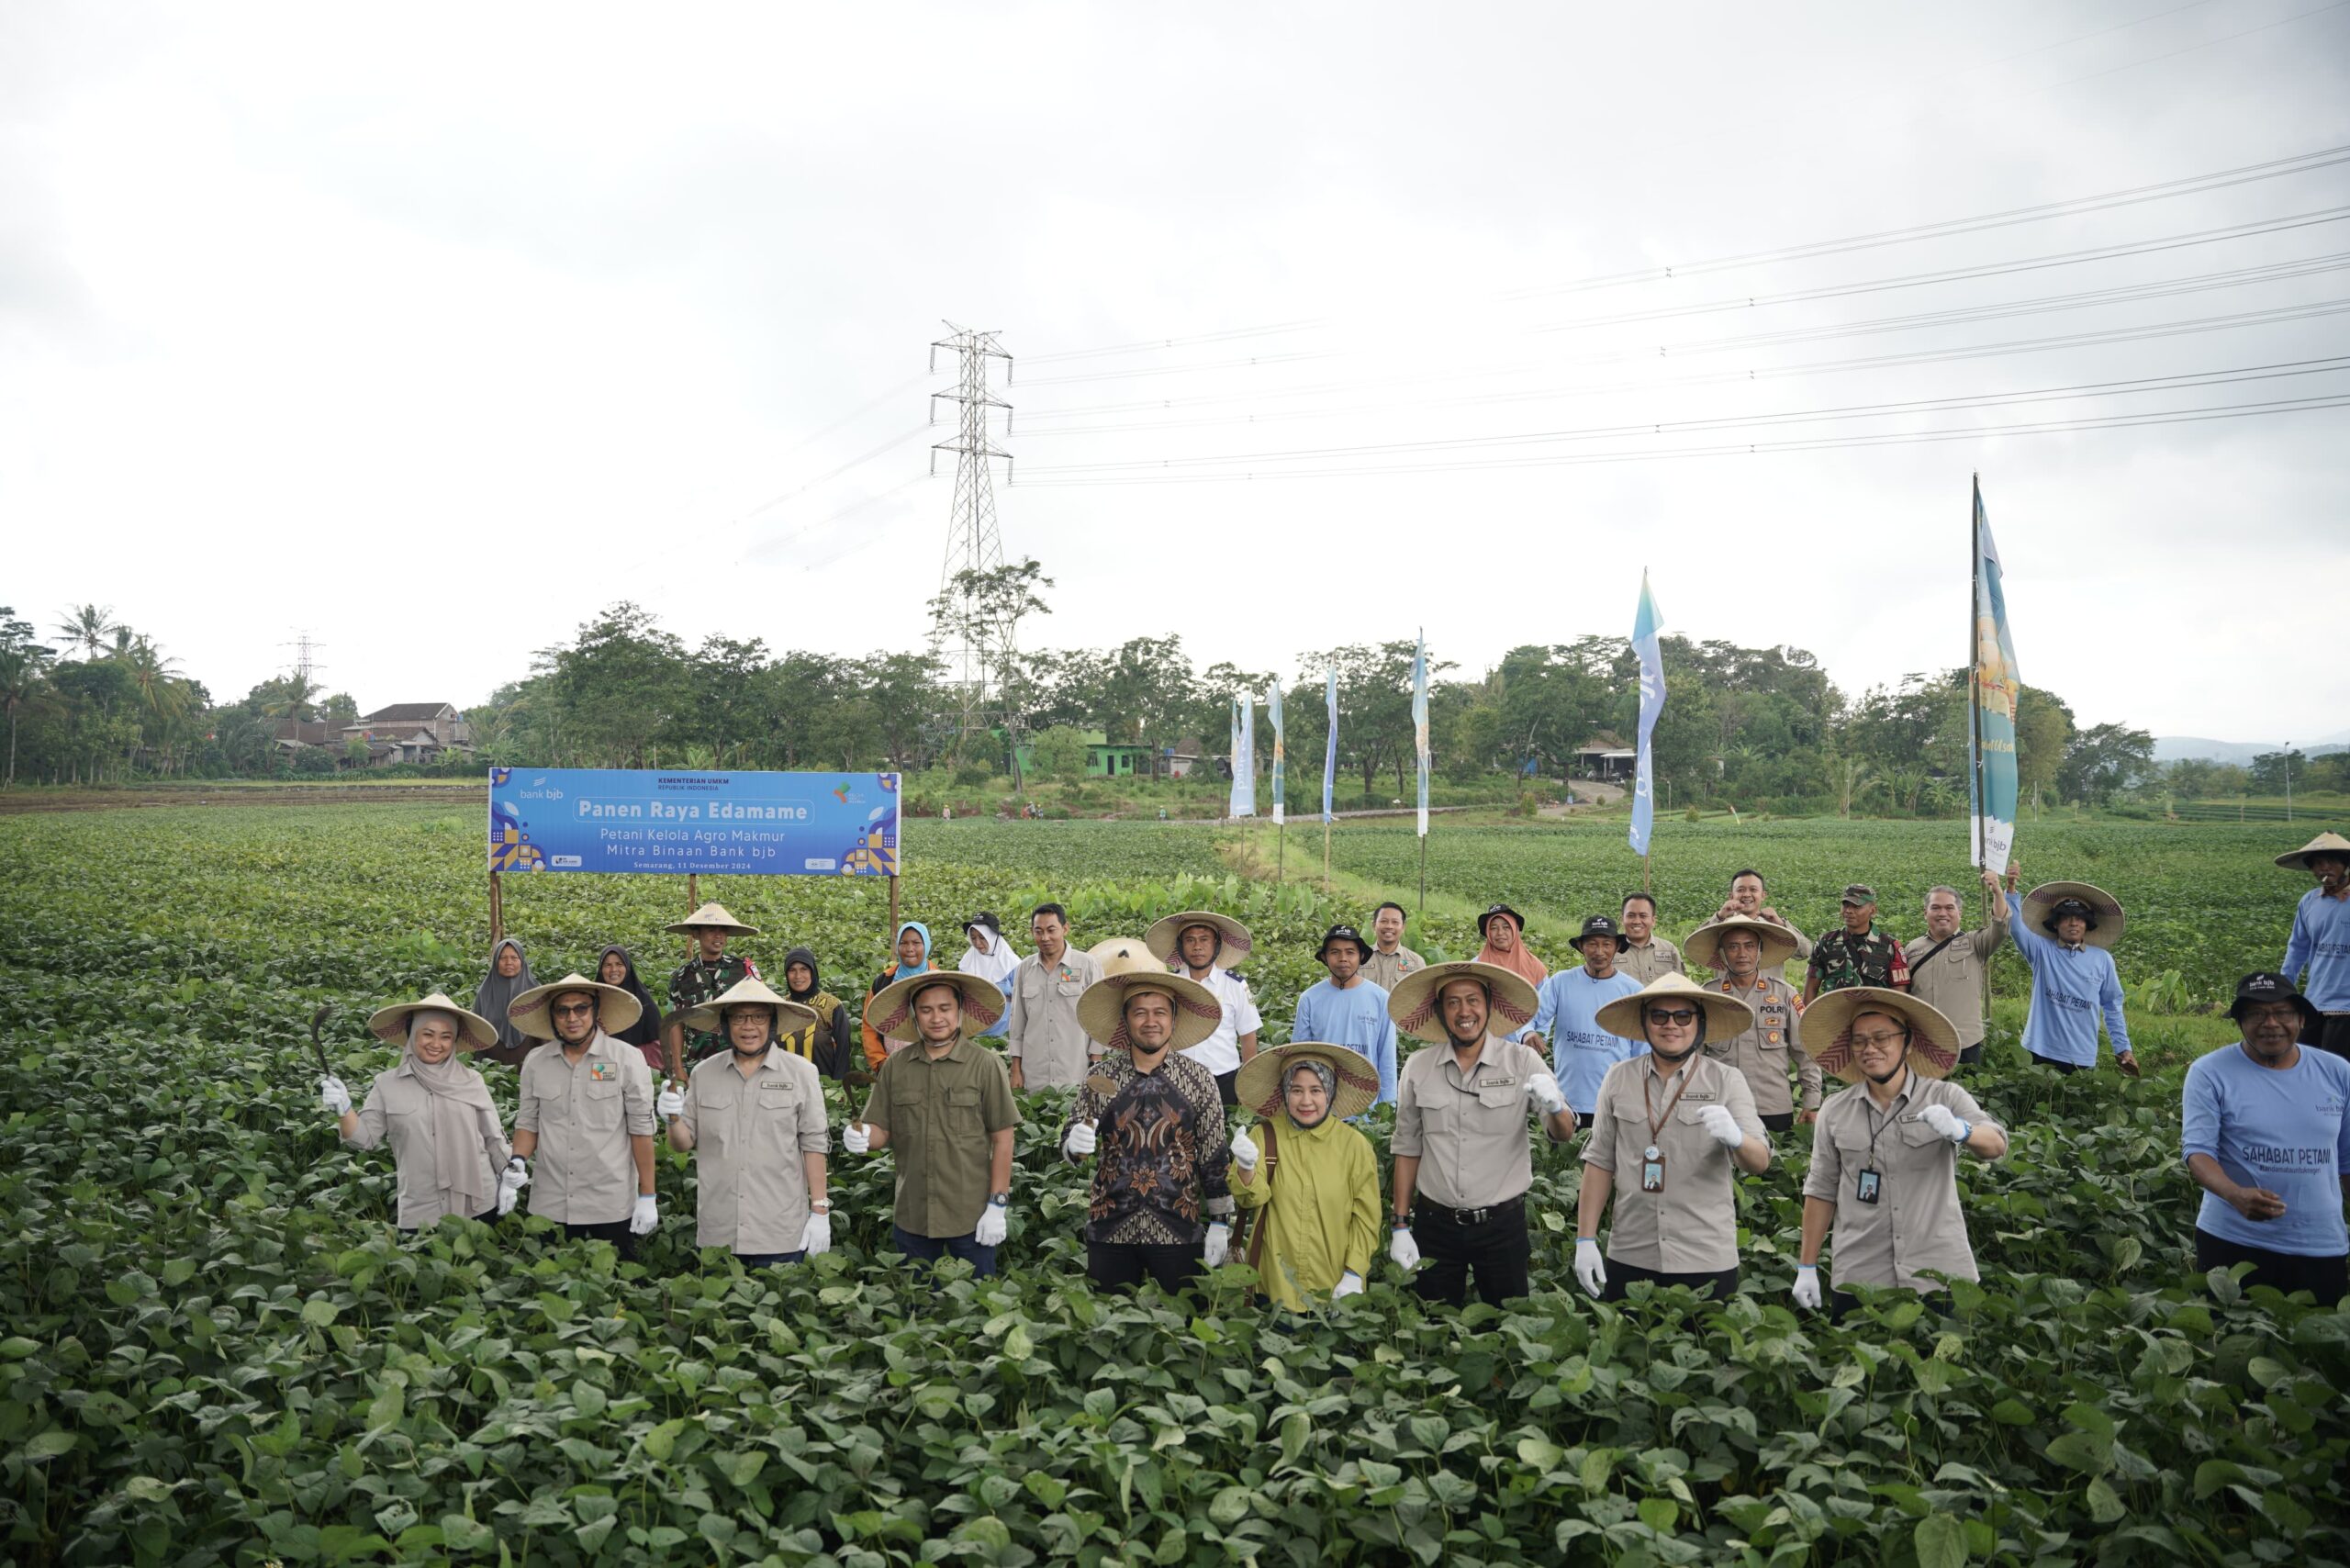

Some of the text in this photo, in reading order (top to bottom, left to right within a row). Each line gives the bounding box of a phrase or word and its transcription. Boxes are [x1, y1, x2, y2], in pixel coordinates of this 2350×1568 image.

[520, 790, 564, 801] bank bjb
[579, 801, 808, 823] Panen Raya Edamame
[600, 828, 785, 844] Petani Kelola Agro Makmur
[607, 845, 776, 859] Mitra Binaan Bank bjb
[1993, 839, 2007, 851] bjb
[1566, 1031, 1595, 1045] SAHABAT
[2243, 1147, 2331, 1165] SAHABAT PETANI
